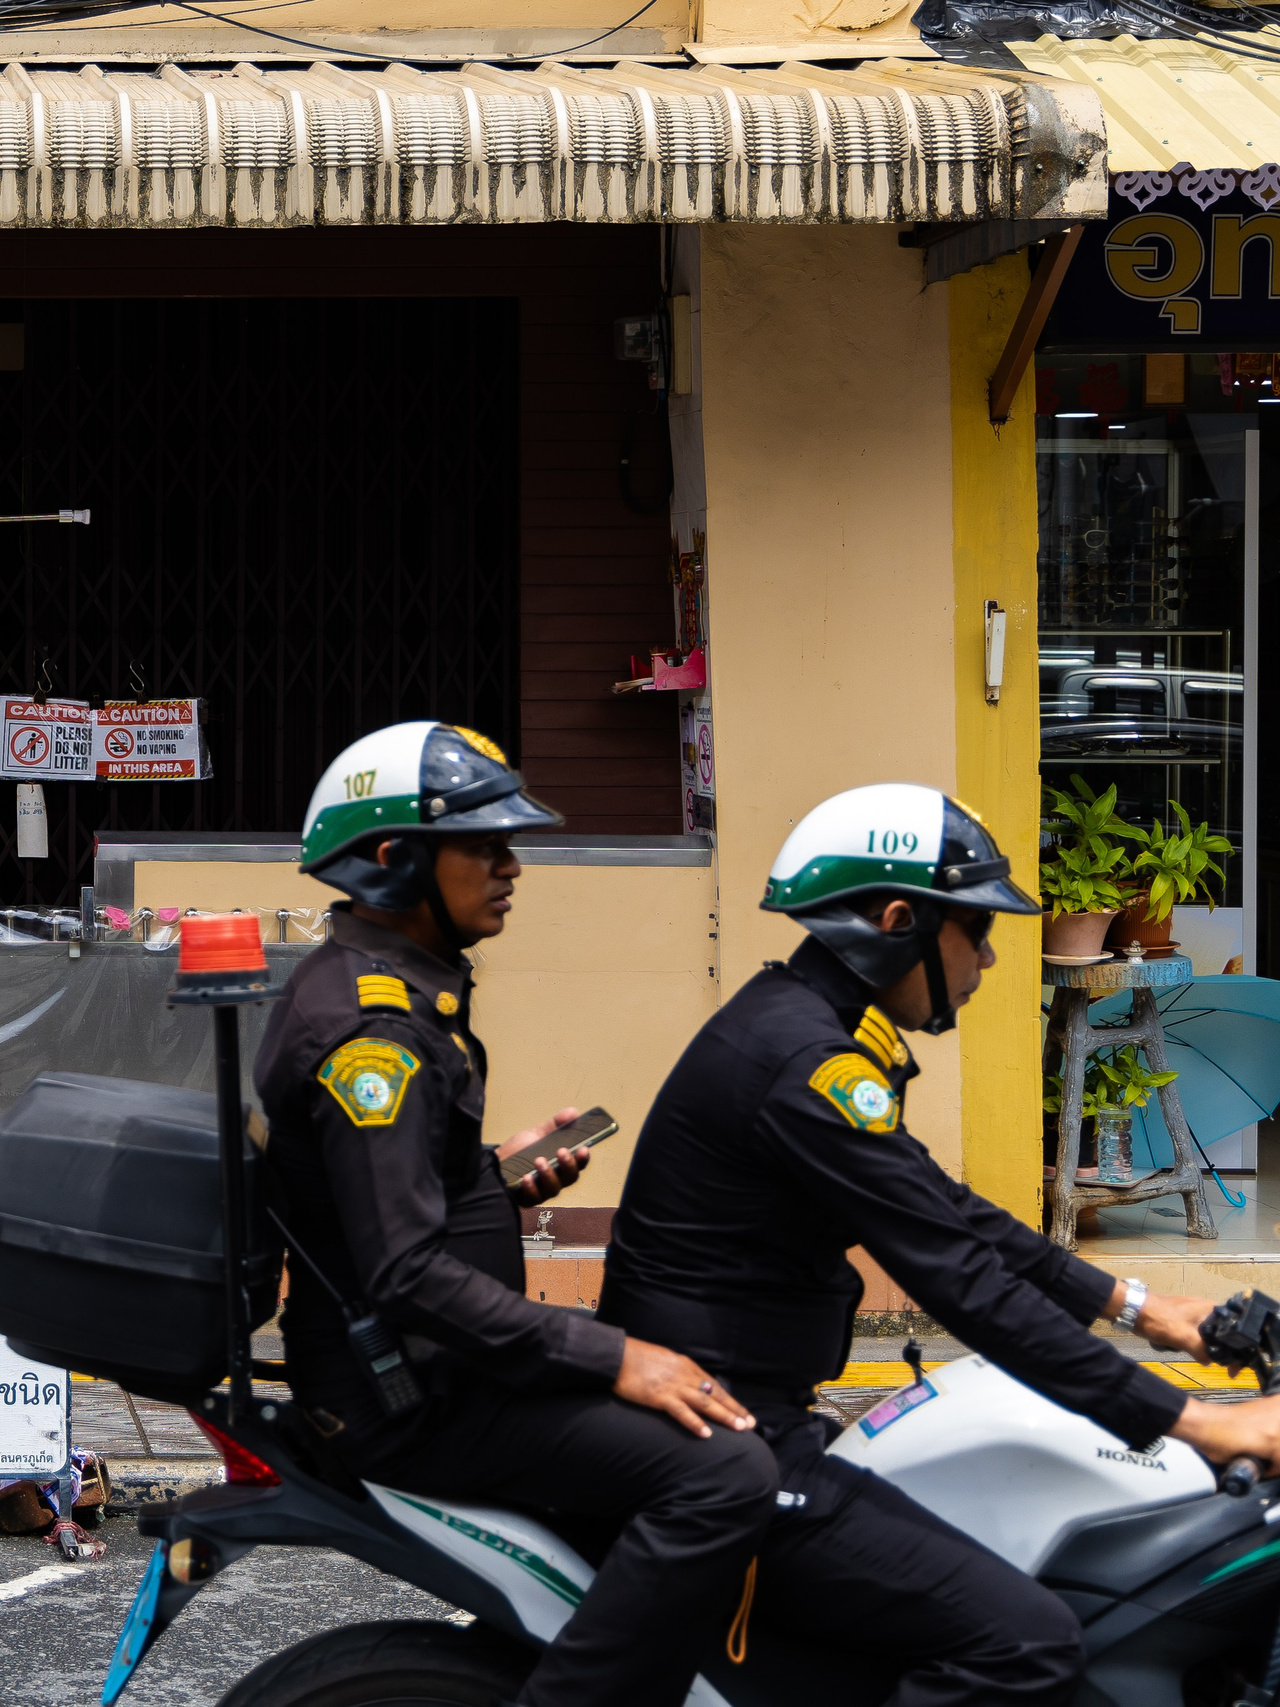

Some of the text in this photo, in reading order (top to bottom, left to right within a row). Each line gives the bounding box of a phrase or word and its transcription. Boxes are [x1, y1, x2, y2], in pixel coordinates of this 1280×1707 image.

[1103, 205, 1280, 335] อุท
[110, 708, 179, 722] CAUTION
[136, 729, 184, 741] NO SMOKING
[55, 741, 92, 756] DO NOT
[136, 744, 177, 755] NO VAPING
[54, 756, 88, 770] LITTER
[108, 762, 183, 773] IN THIS AREA
[343, 769, 377, 800] 107
[867, 829, 919, 855] 109
[1097, 1447, 1168, 1473] HONDA
